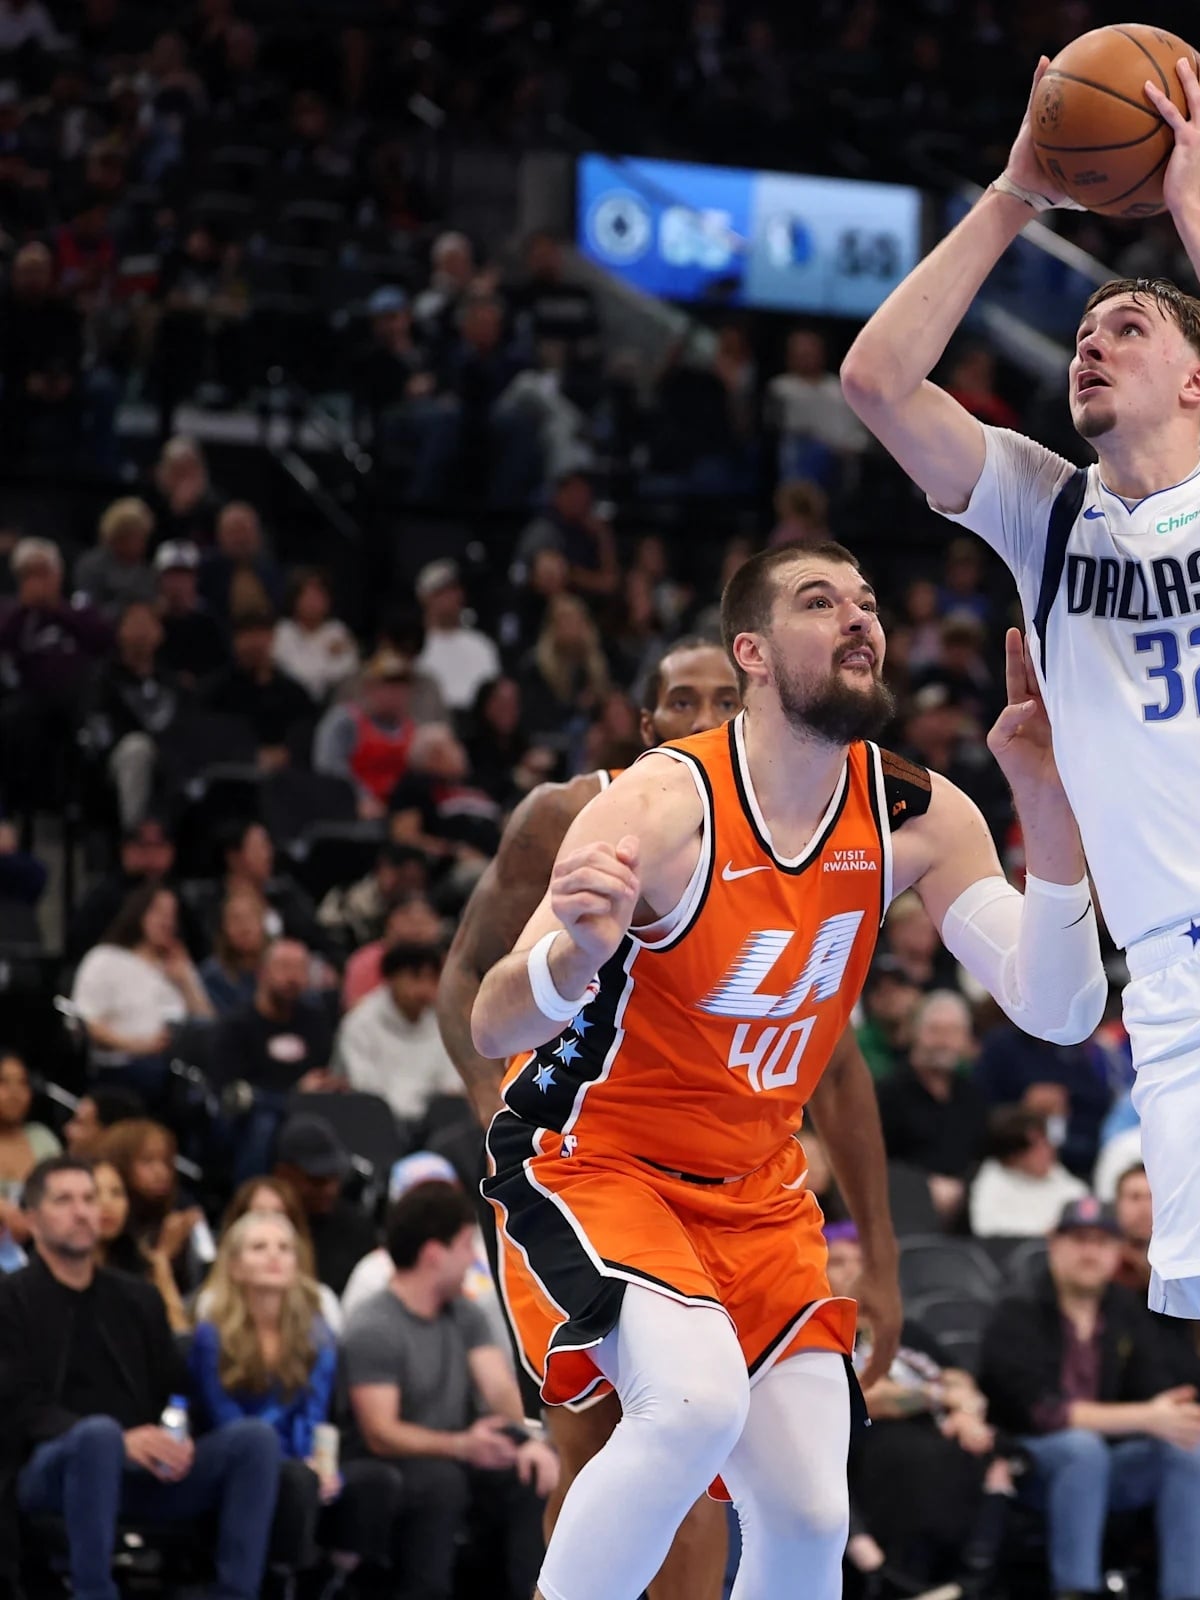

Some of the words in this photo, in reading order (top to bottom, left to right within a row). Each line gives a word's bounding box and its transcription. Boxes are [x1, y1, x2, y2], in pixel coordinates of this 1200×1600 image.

[823, 860, 877, 873] RWANDA
[833, 849, 866, 861] VISIT
[695, 909, 866, 1019] LA
[728, 1015, 817, 1093] 40
